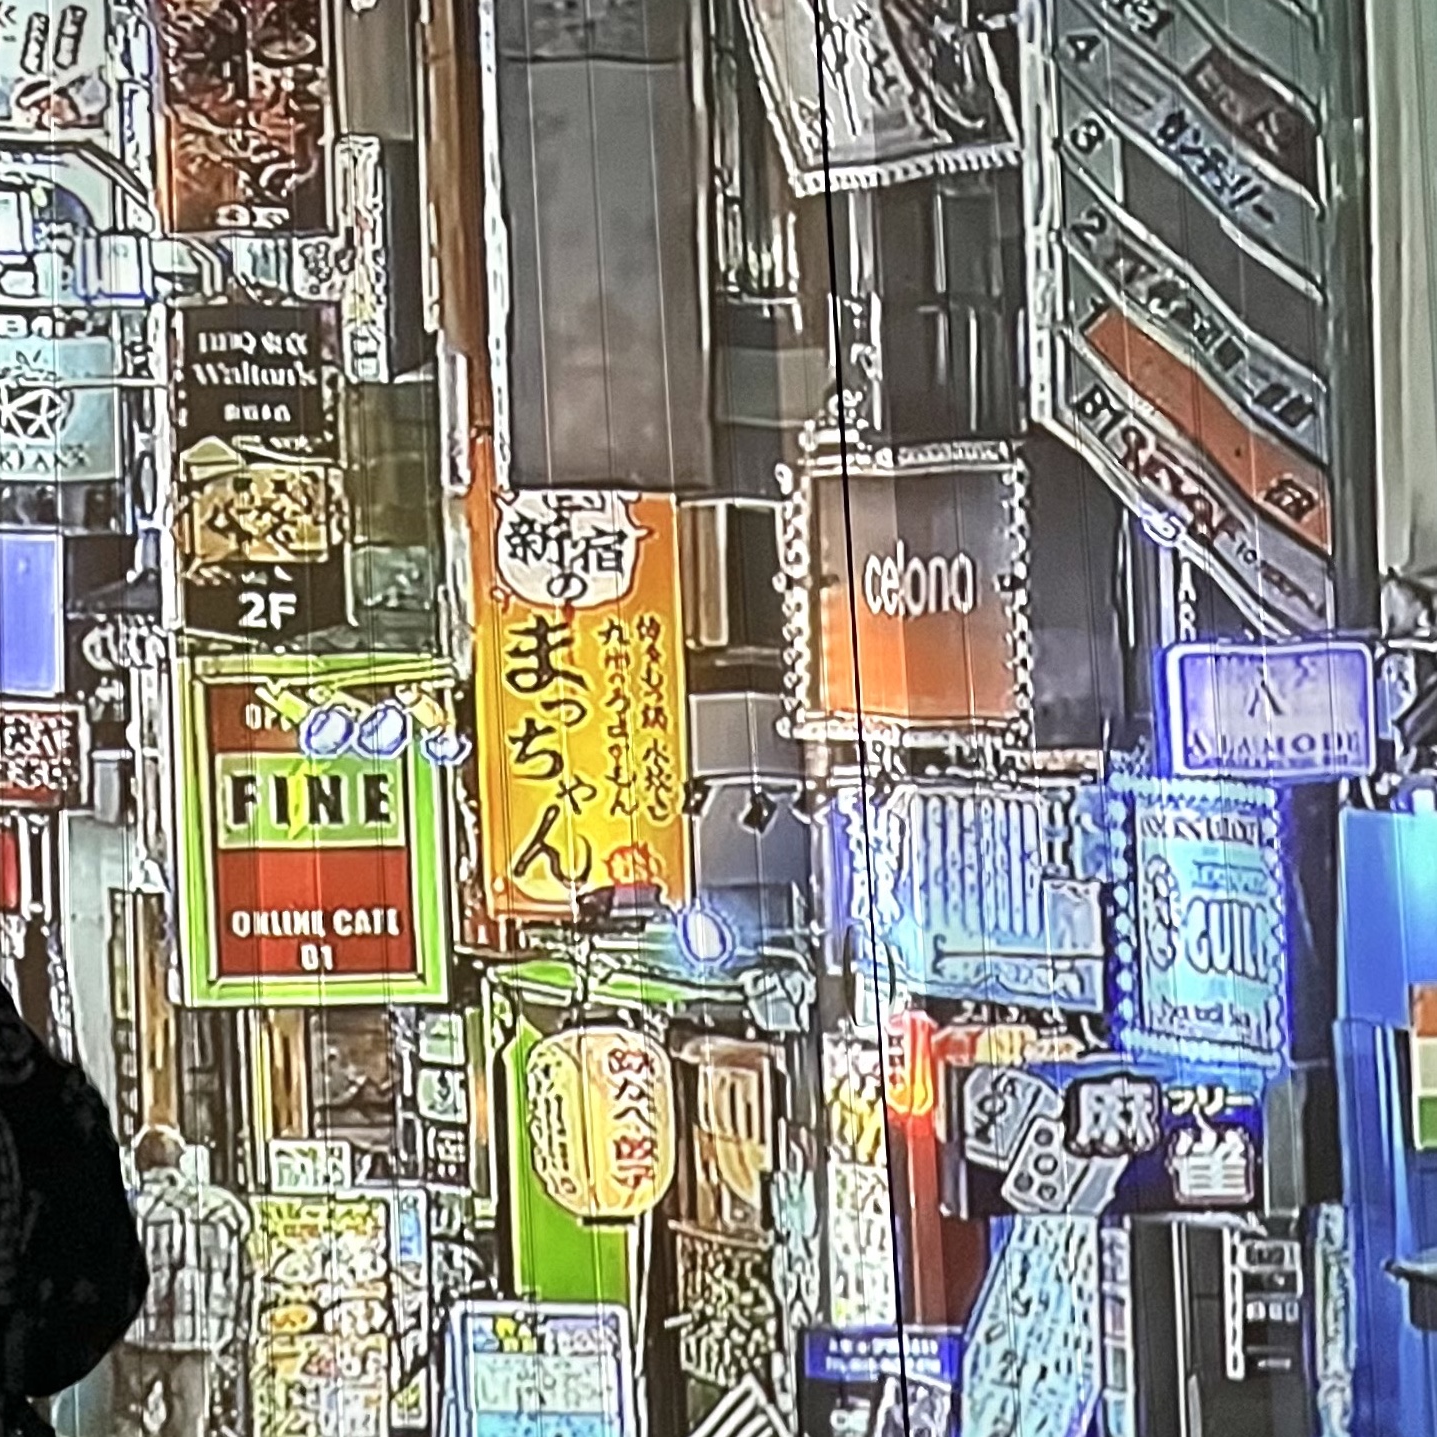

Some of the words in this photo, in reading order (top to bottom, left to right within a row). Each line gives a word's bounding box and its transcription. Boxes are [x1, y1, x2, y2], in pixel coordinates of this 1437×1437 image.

[239, 591, 297, 629] 2F
[504, 614, 599, 886] まっちゃん
[229, 772, 395, 828] FINE
